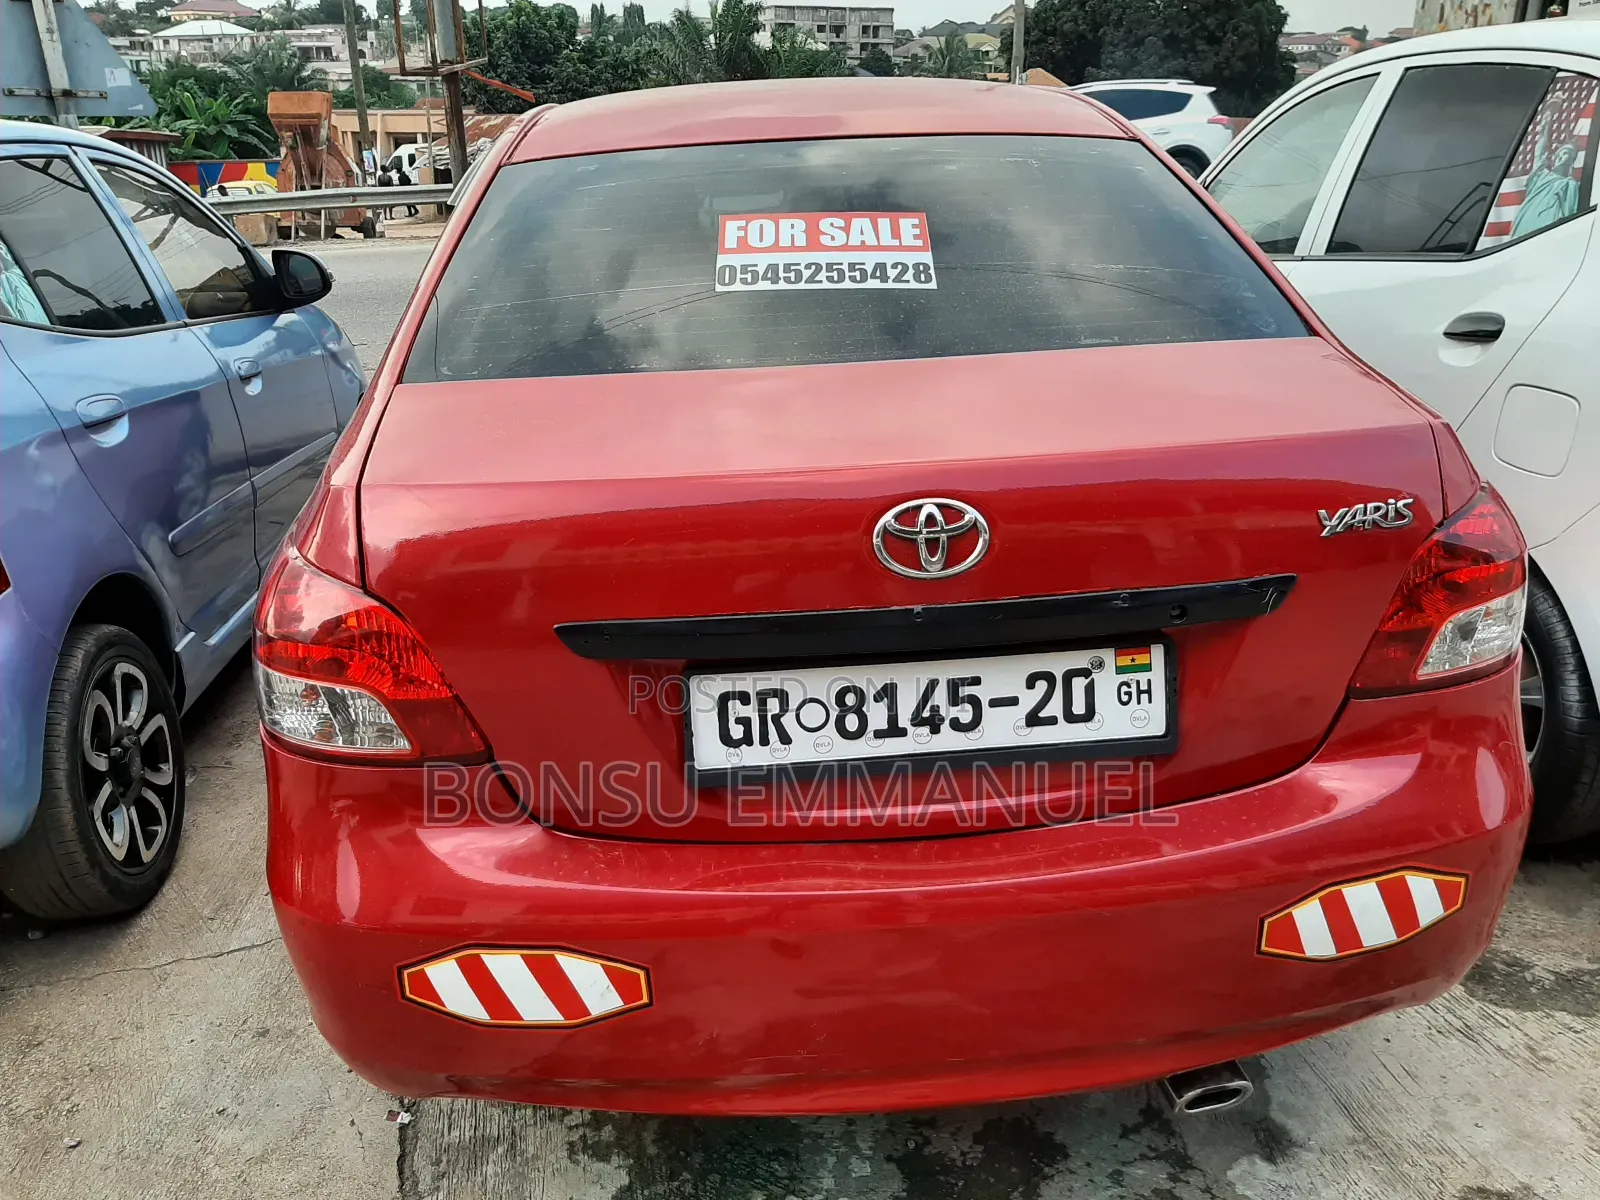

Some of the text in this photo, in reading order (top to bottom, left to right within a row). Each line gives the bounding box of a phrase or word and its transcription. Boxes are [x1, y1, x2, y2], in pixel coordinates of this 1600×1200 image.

[724, 217, 924, 249] FOR SALE
[717, 261, 933, 287] 0545255428
[717, 666, 1097, 749] GR 8145-20
[1116, 677, 1153, 707] GH
